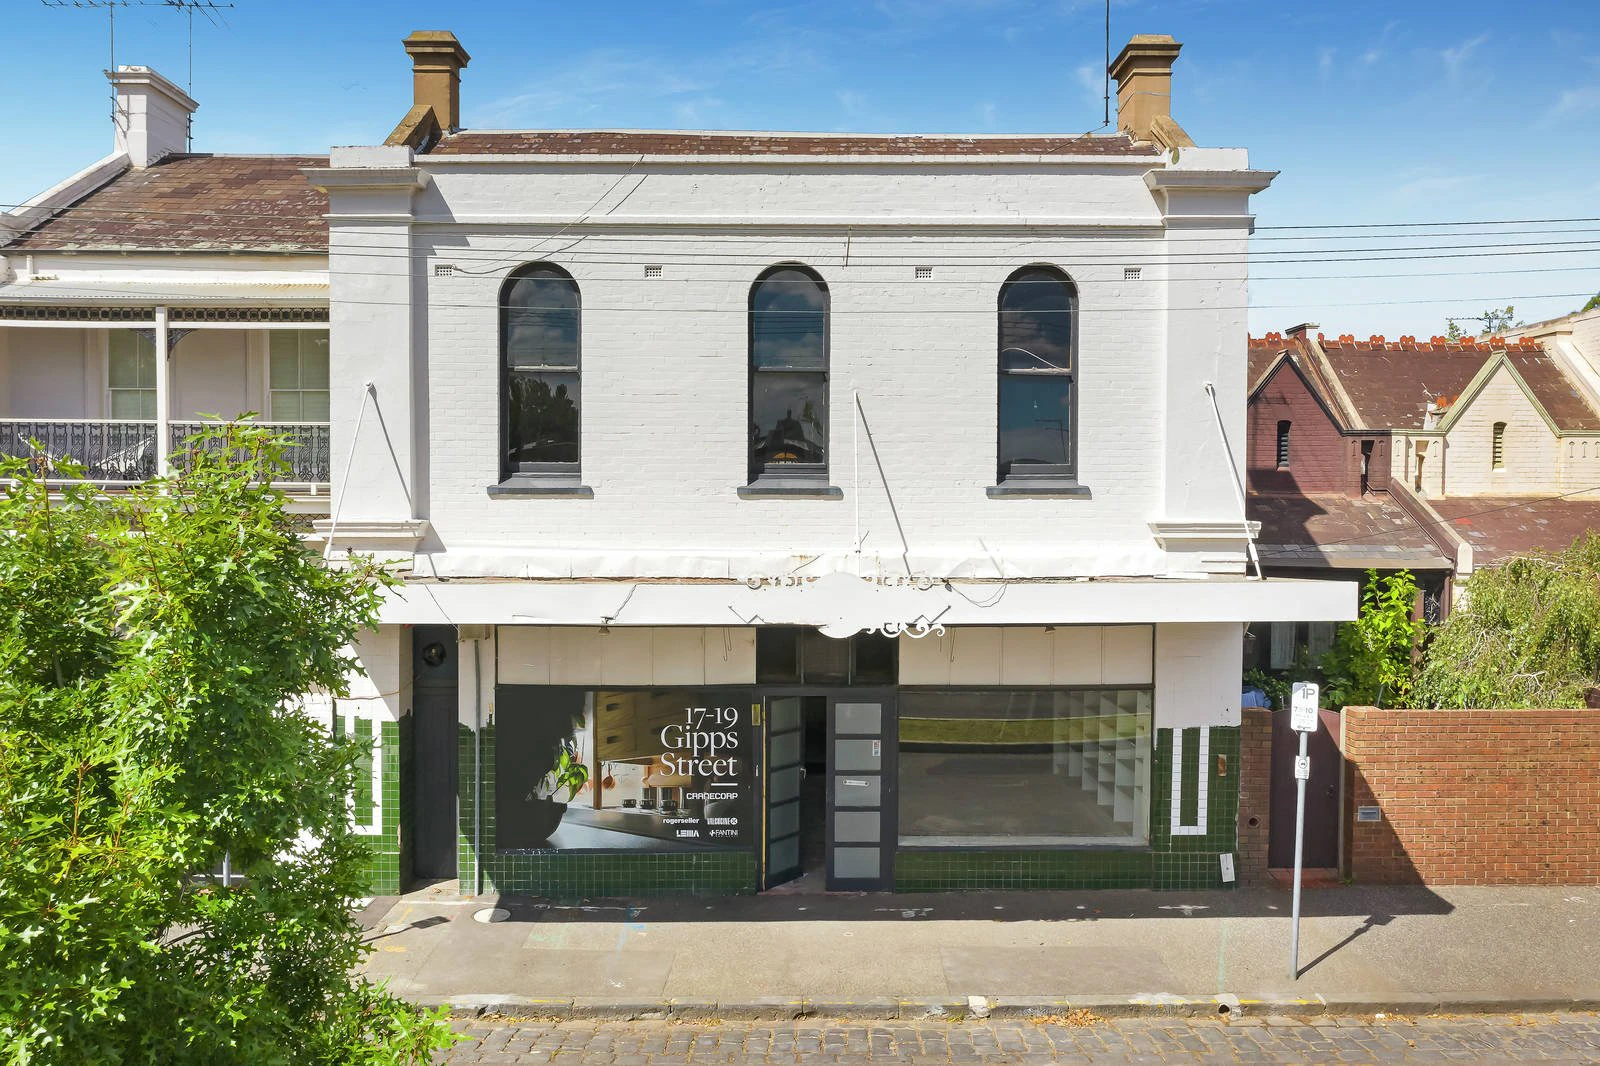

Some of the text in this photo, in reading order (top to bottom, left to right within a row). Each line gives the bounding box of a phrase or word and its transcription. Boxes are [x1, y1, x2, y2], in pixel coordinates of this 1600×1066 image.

[1302, 687, 1316, 700] 1P
[684, 707, 739, 730] 17-19
[660, 724, 739, 757] Gipps
[660, 752, 738, 776] Street
[686, 792, 738, 800] CRANECORP
[662, 817, 700, 825] rogerseller
